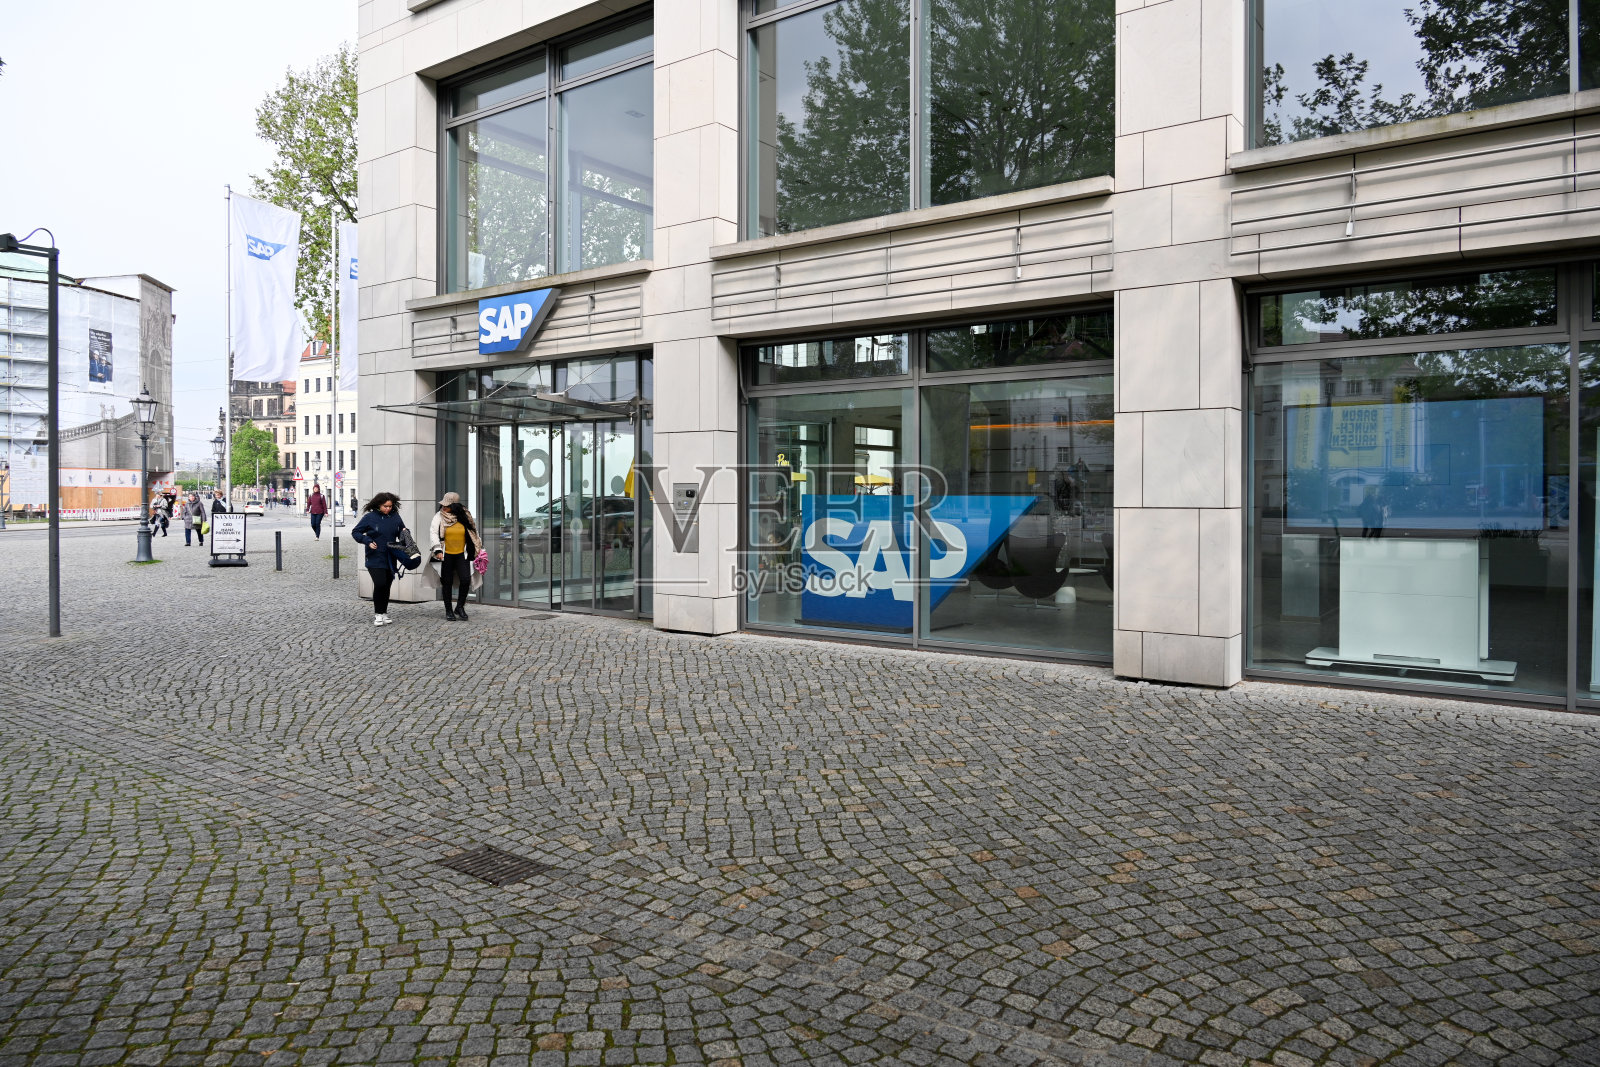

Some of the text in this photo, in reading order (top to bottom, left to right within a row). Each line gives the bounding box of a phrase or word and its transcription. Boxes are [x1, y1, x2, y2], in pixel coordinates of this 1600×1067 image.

[247, 238, 274, 256] SAP
[479, 303, 533, 344] SAP
[804, 517, 967, 602] SAP
